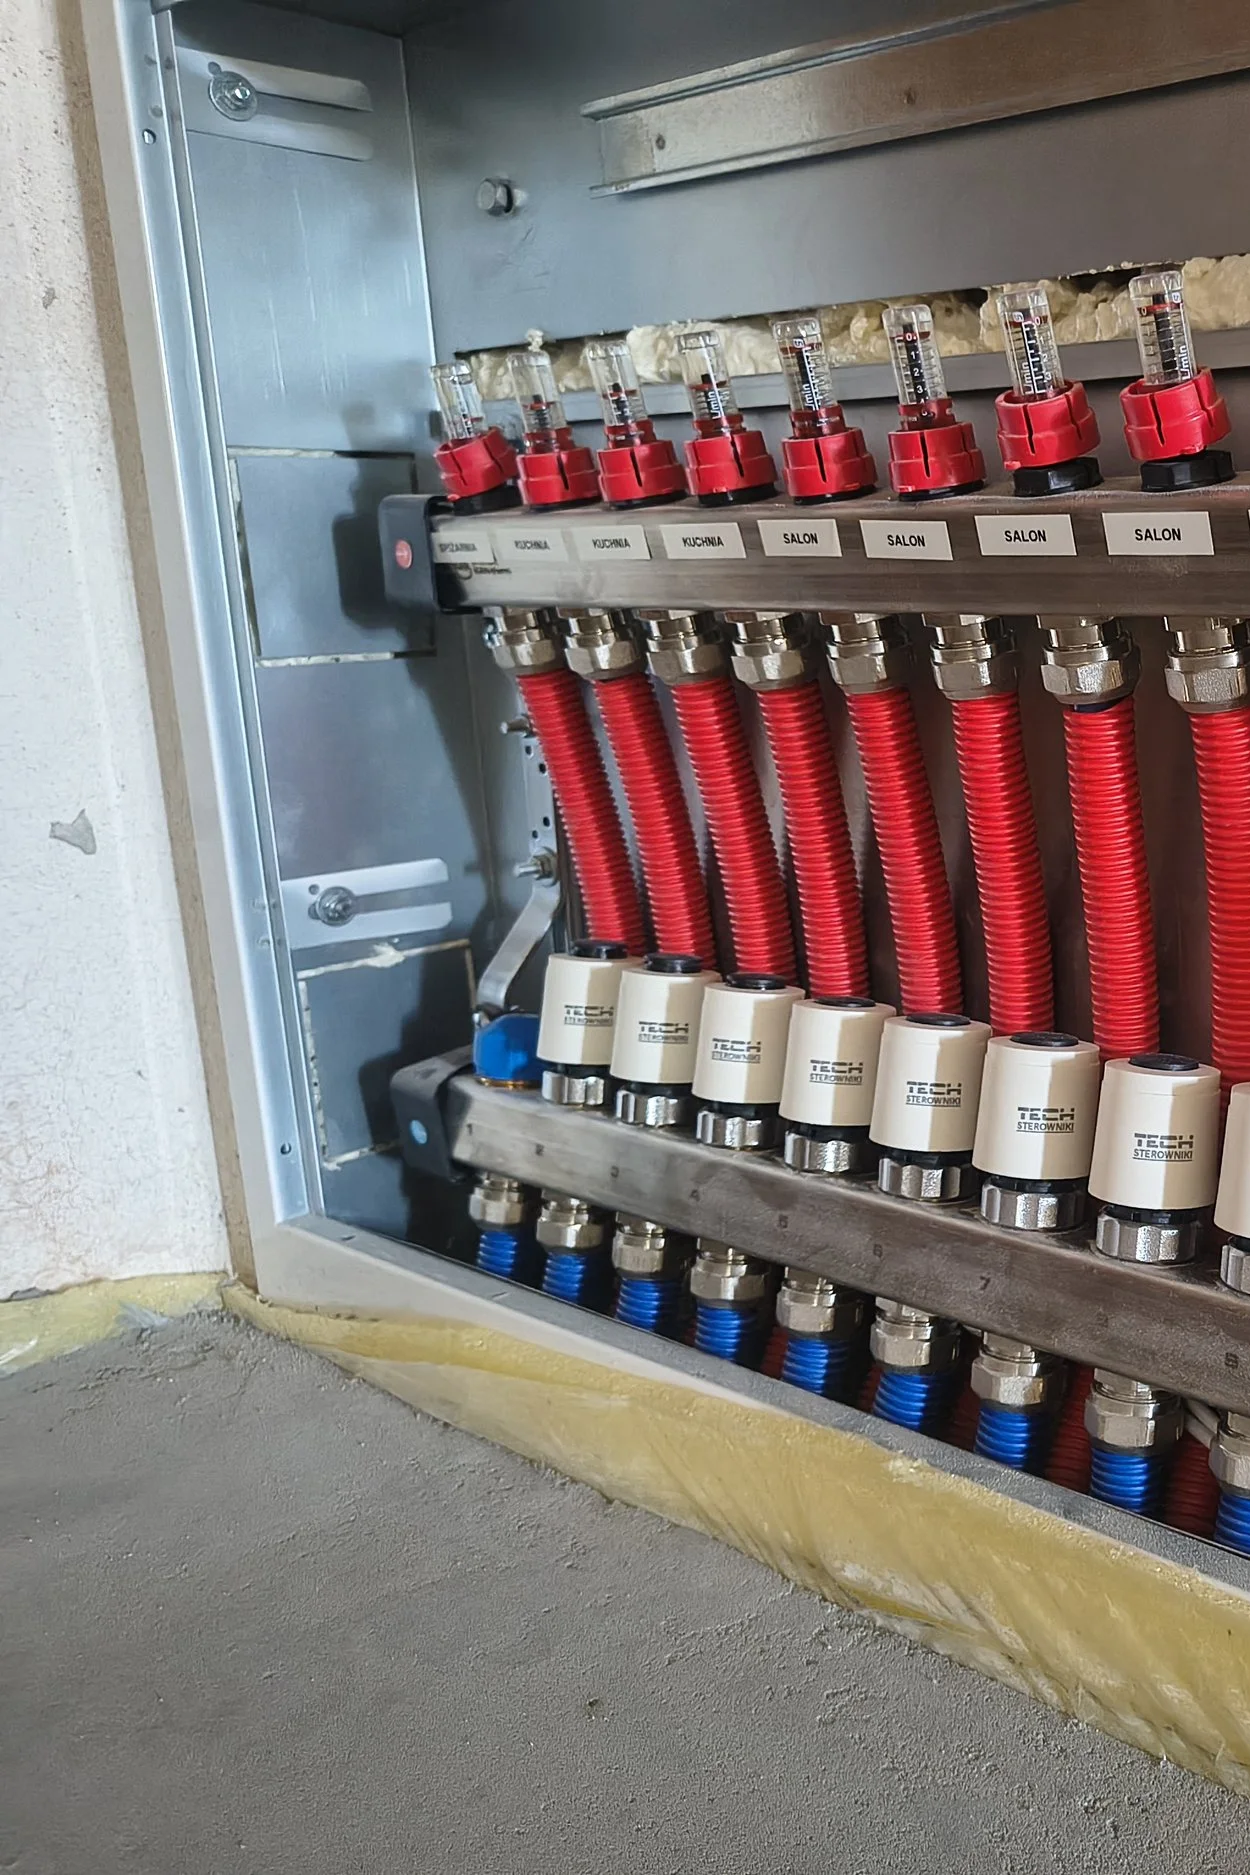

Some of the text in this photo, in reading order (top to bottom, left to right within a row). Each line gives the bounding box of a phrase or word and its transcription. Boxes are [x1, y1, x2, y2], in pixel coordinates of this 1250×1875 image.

[1178, 345, 1191, 380] L/min
[913, 368, 920, 377] 2
[1021, 361, 1034, 395] L/min
[783, 532, 818, 545] SALON
[887, 534, 926, 547] SALON
[1004, 529, 1047, 543] SALON
[1134, 528, 1182, 541] SALON
[592, 537, 631, 549] KUCHNIA
[682, 536, 724, 547] KUCHNIA
[638, 1020, 689, 1033] TECH
[810, 1059, 863, 1074] TECH
[906, 1081, 962, 1096] TECH
[906, 1095, 961, 1106] STEROWNIKI
[1017, 1106, 1075, 1121] TECH
[1016, 1121, 1074, 1131] STEROWNIKI
[1133, 1132, 1194, 1149] TECH
[1132, 1148, 1193, 1160] STEROWNIKI
